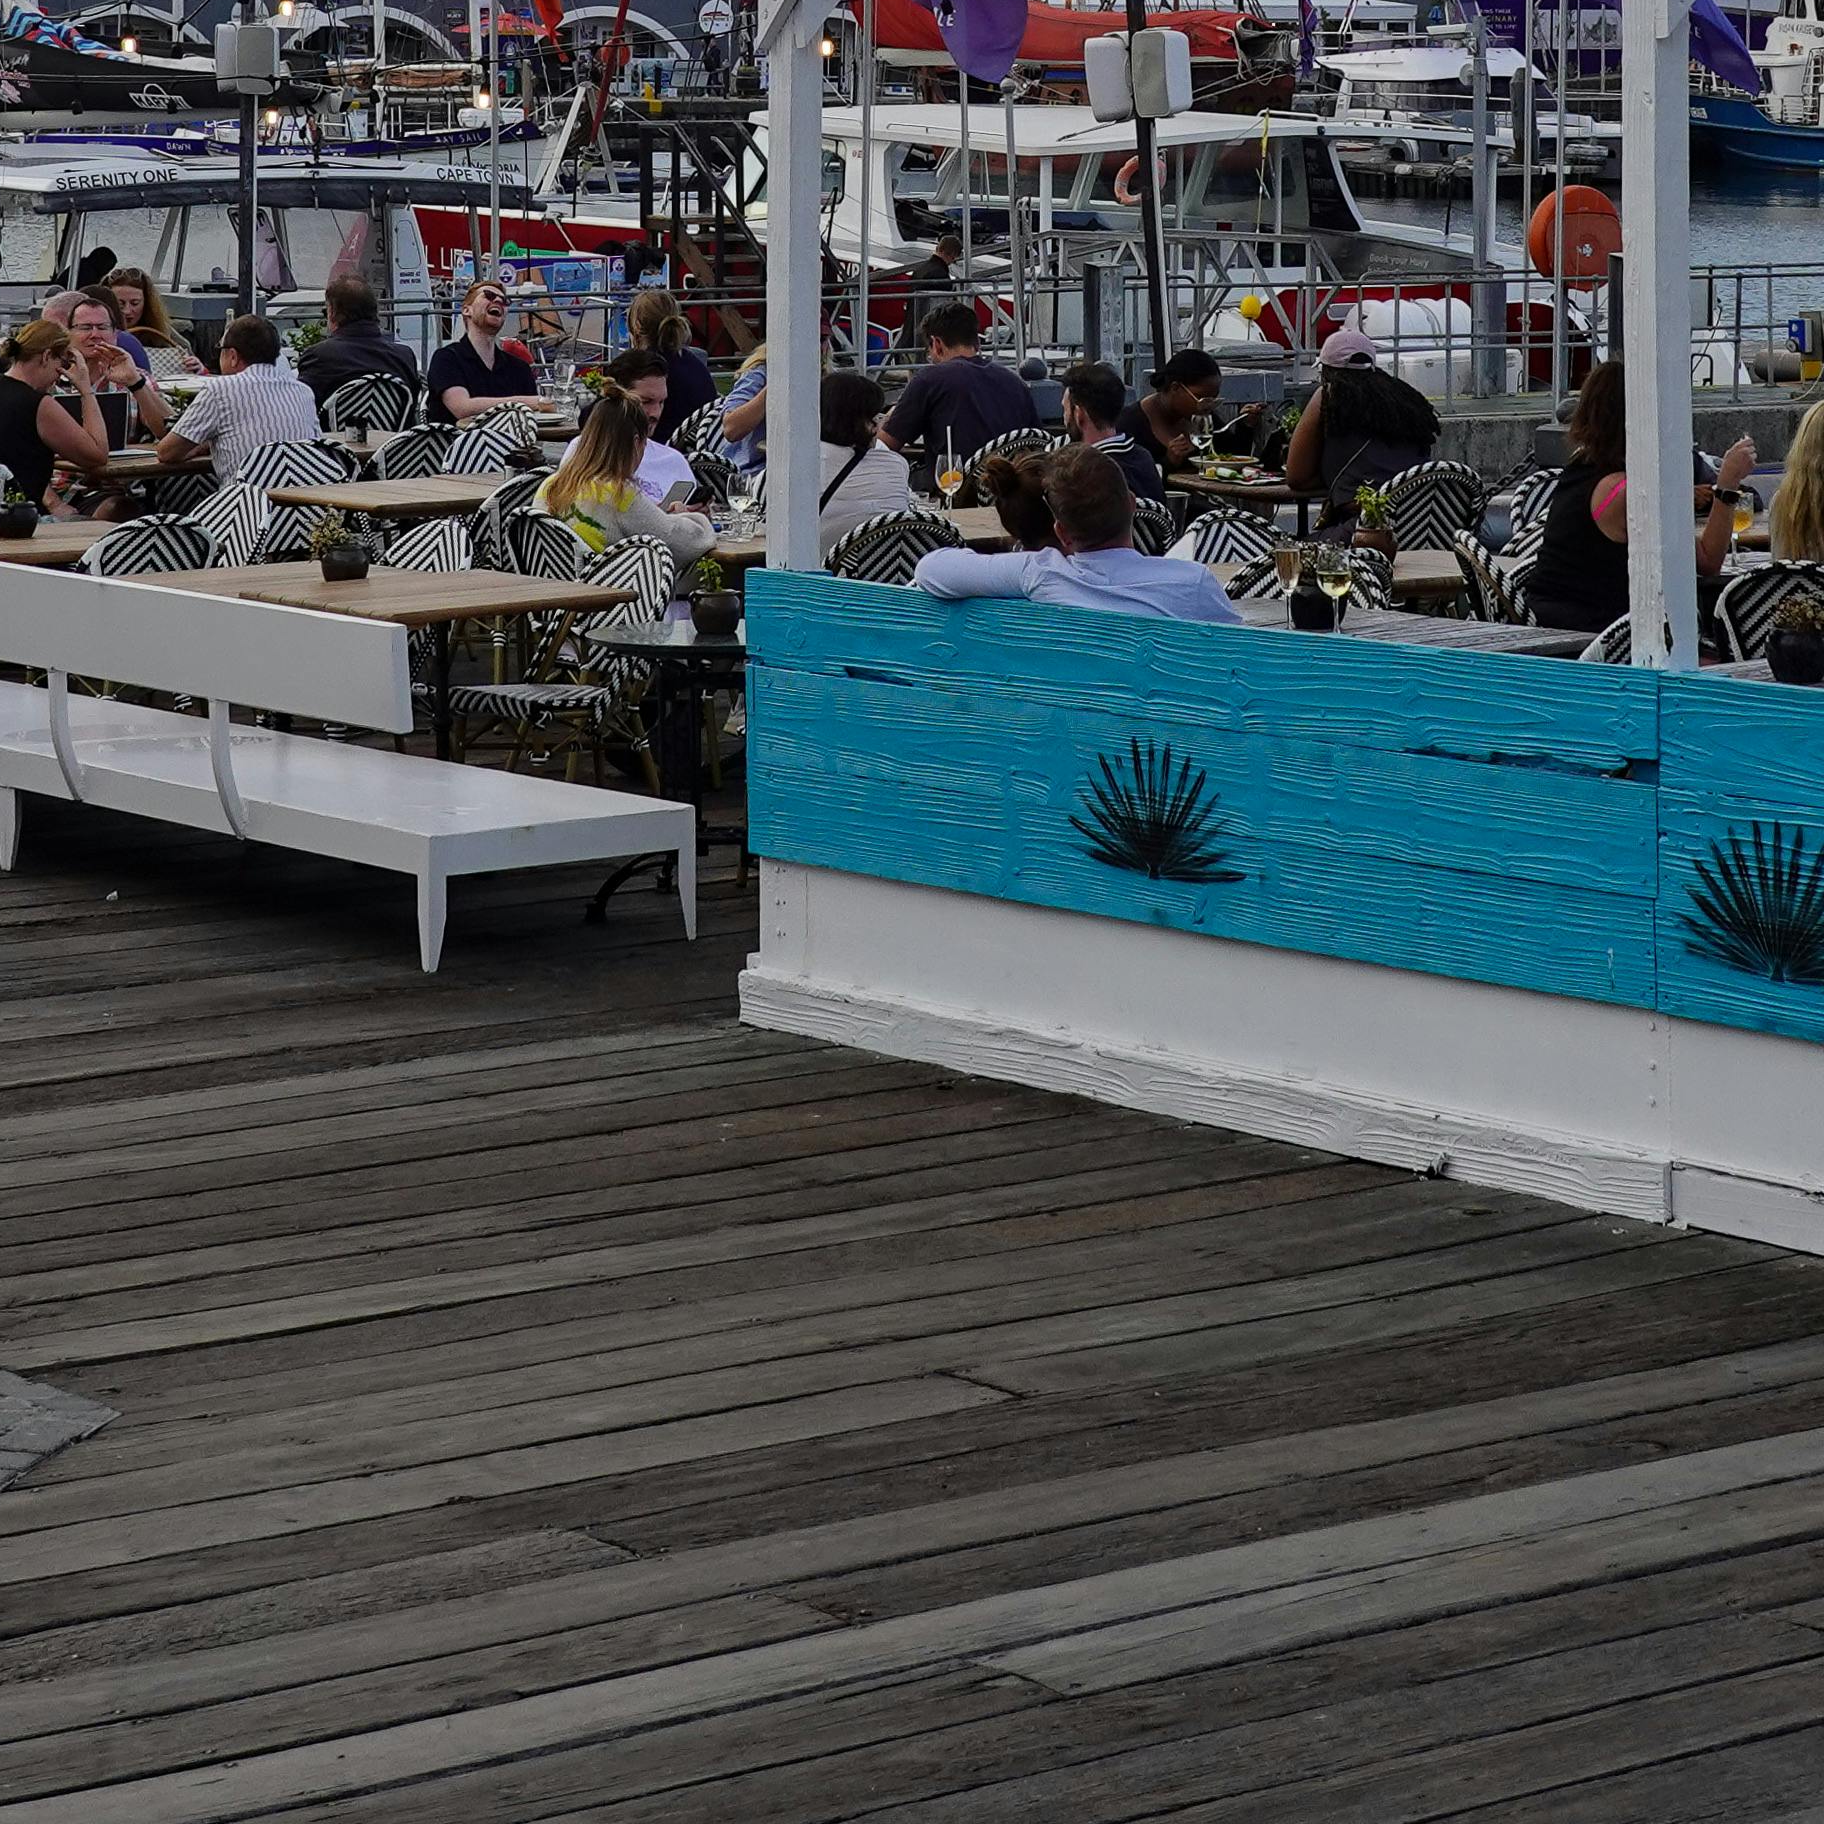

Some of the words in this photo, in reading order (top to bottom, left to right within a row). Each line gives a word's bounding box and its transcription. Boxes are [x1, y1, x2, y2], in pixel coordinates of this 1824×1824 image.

[56, 171, 140, 191] SERENITY
[143, 168, 178, 183] ONE
[437, 167, 472, 182] CAPE
